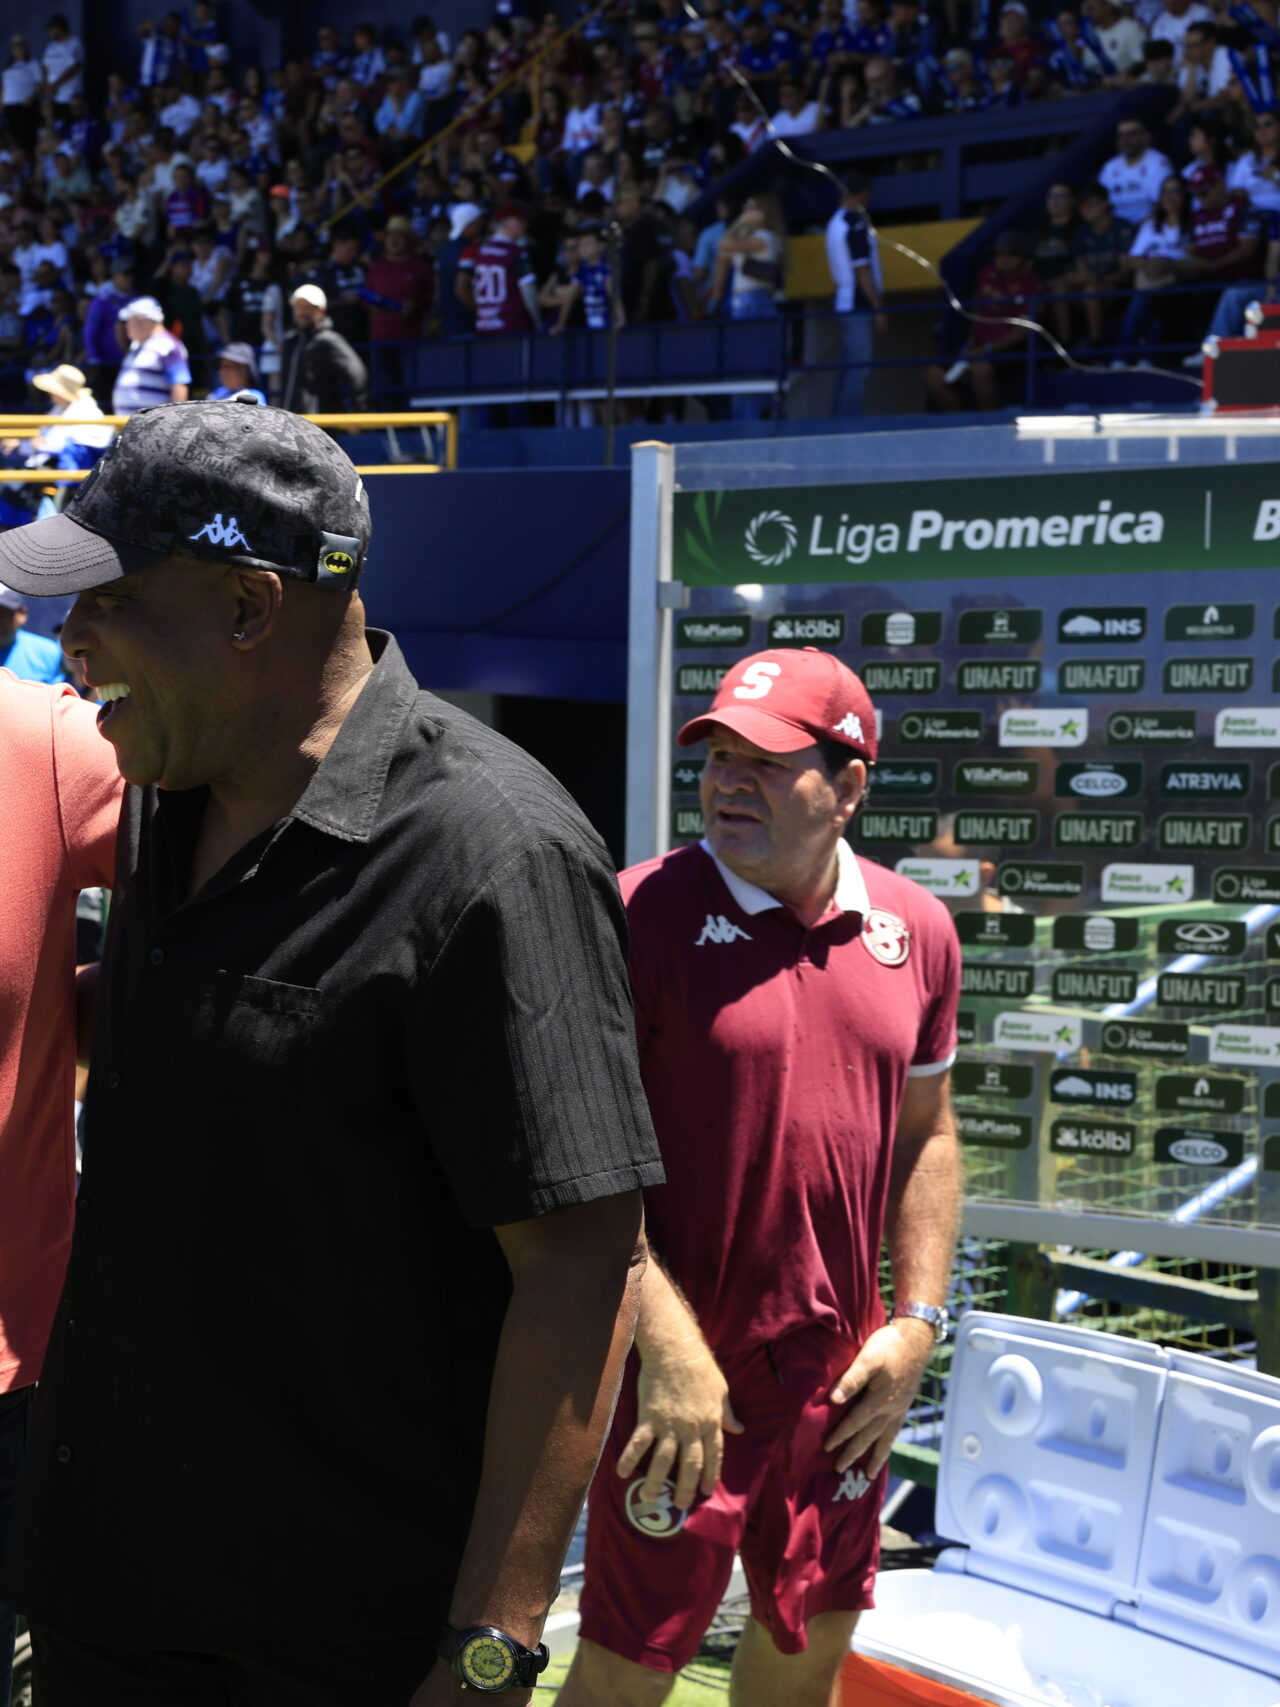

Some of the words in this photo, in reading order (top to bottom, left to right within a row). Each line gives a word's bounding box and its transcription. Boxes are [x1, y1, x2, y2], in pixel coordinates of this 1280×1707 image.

[809, 513, 900, 564] Liga
[907, 500, 1164, 552] Promerica
[794, 619, 841, 638] kölbi
[1104, 618, 1142, 636] INS
[680, 669, 724, 690] UNAF
[733, 661, 782, 699] S
[865, 667, 936, 689] UNAFUT
[963, 666, 1036, 689] UNAFUT
[1065, 665, 1141, 688] UNAFUT
[1171, 663, 1249, 687] UNAFUT
[1074, 777, 1122, 790] CELCO
[862, 816, 932, 838] UNAFUT
[959, 818, 1032, 840] UNAFUT
[1060, 819, 1136, 842] UNAFUT
[1165, 821, 1244, 845] UNAFUT
[1057, 973, 1132, 998] UNAFUT
[1163, 978, 1240, 1004] UNAFUT
[1095, 1082, 1133, 1100] INS
[1080, 1128, 1132, 1151] kölbi
[1174, 1144, 1223, 1159] CELCO
